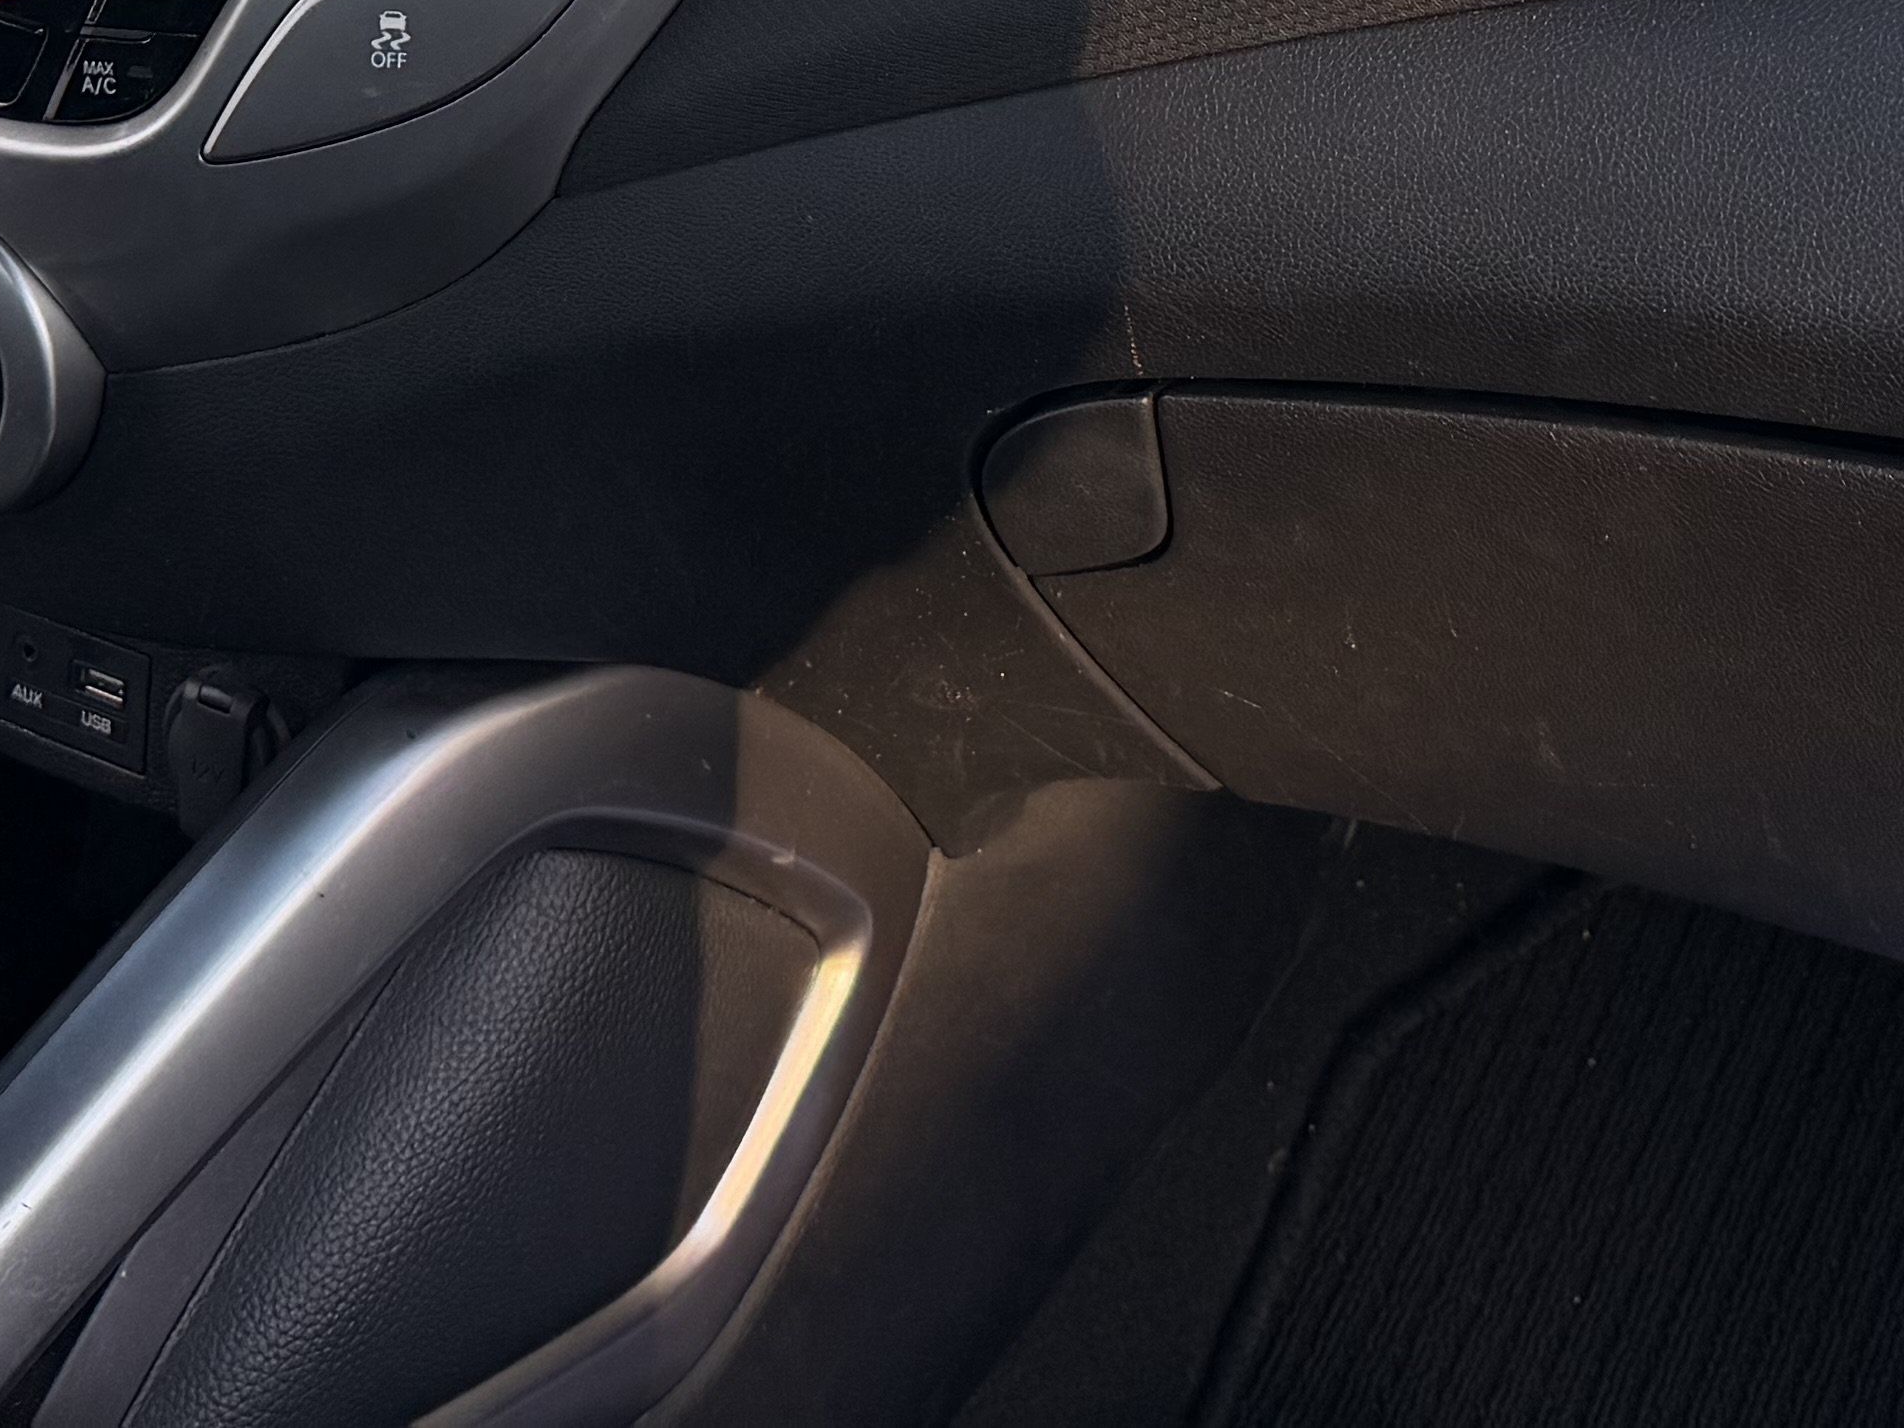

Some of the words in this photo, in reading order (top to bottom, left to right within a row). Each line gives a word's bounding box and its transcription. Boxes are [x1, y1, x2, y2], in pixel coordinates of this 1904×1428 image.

[83, 60, 114, 76] MAX
[371, 51, 407, 69] OFF
[81, 75, 117, 96] A/C
[11, 683, 43, 710] AUX
[81, 710, 112, 736] USB
